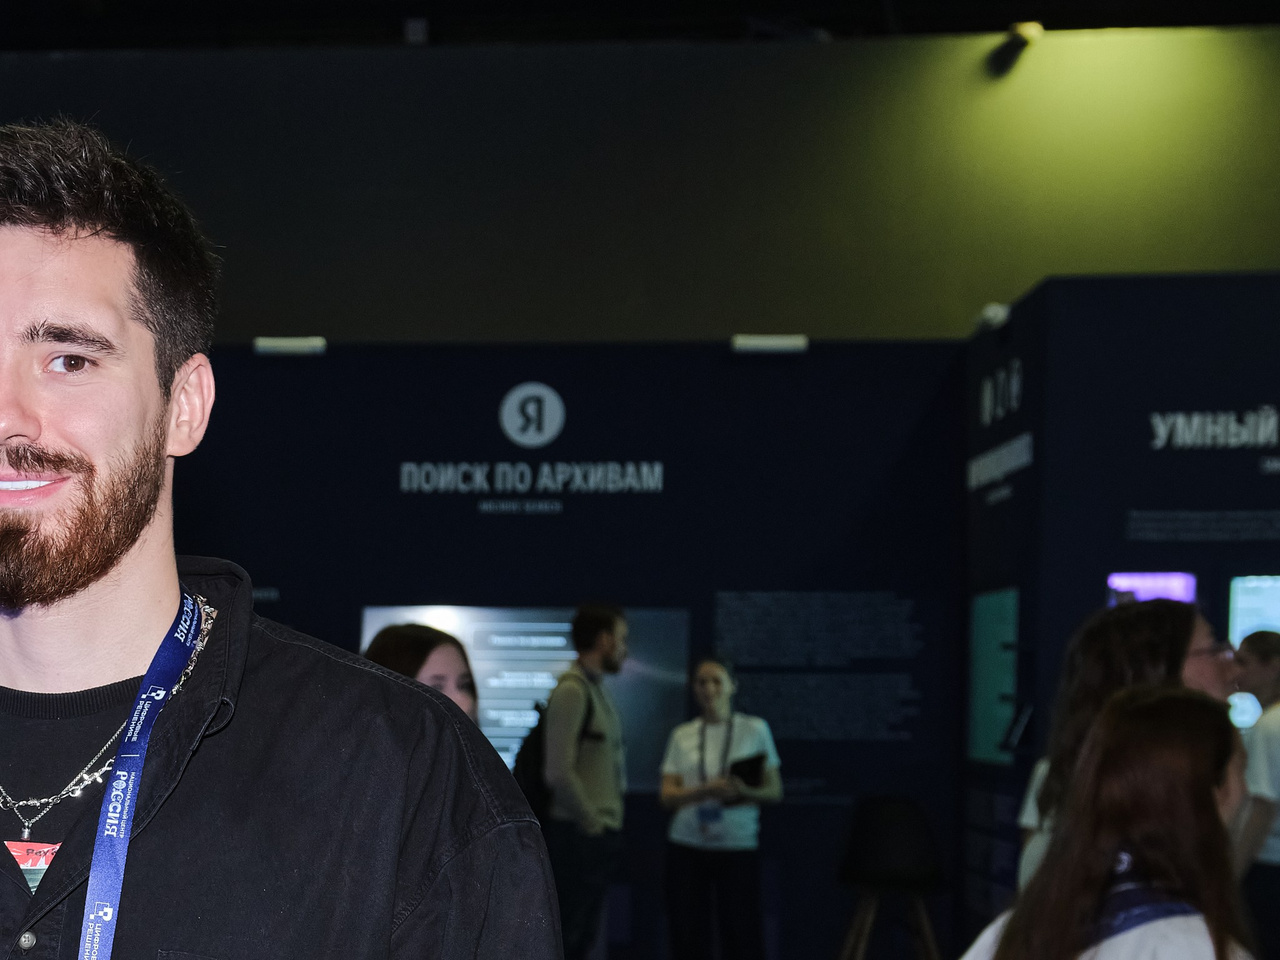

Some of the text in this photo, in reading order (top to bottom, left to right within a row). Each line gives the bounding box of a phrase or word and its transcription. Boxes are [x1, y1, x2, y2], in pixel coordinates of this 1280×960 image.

[1150, 404, 1279, 449] УМНЫЙ
[400, 462, 664, 492] ПОИСК ПО АРХИВАМ
[173, 592, 194, 643] РОССИЯ
[130, 700, 152, 742] ЦИФРОВЫЕ
[104, 770, 129, 838] РОССИЯ
